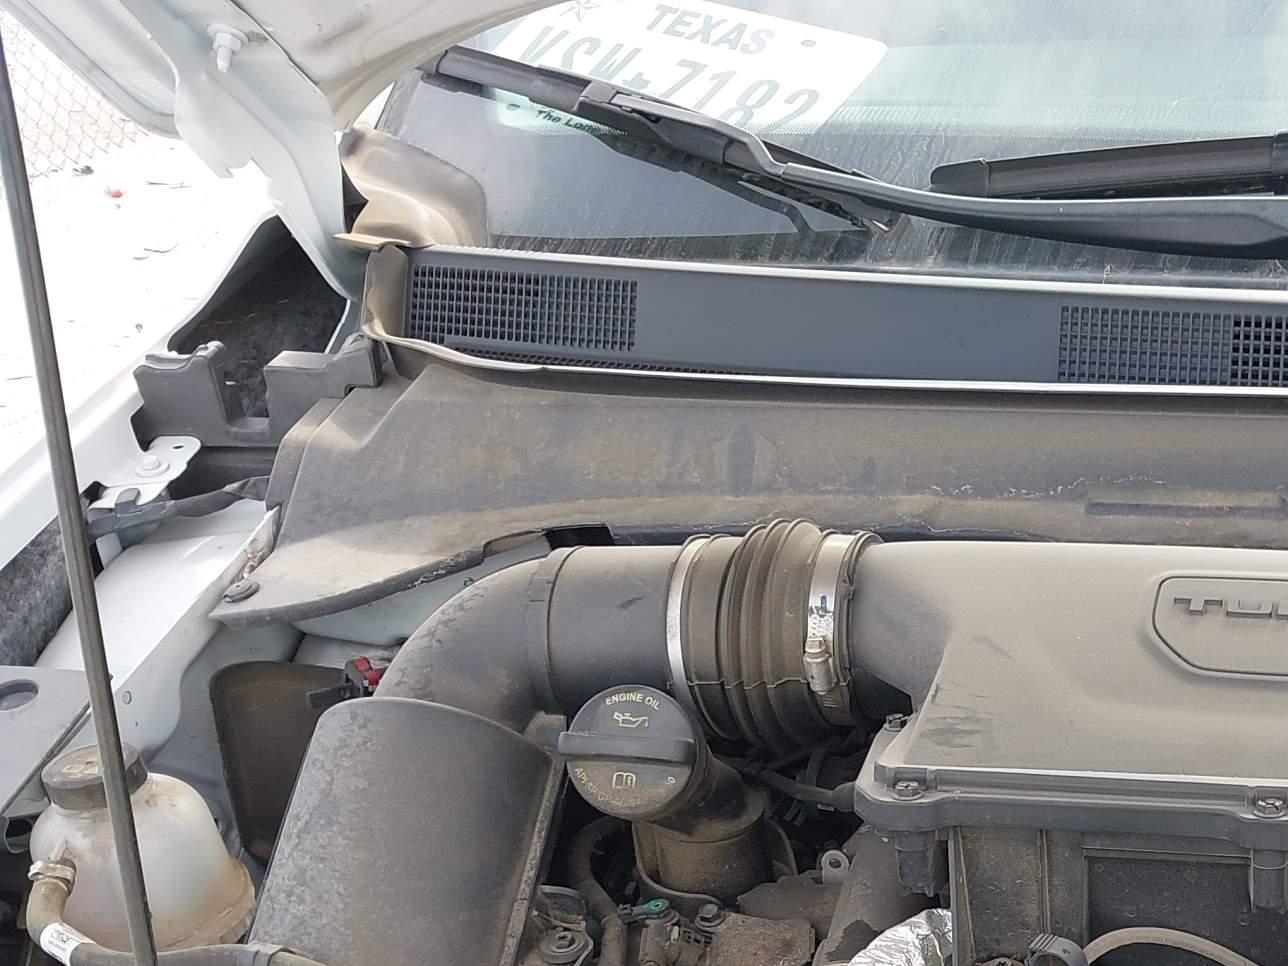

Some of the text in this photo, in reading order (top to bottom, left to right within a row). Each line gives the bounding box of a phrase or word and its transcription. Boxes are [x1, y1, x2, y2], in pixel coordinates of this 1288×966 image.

[646, 4, 775, 55] TEXAS
[659, 59, 820, 133] 7182
[535, 108, 562, 124] The
[605, 692, 662, 711] ENGINE OIL
